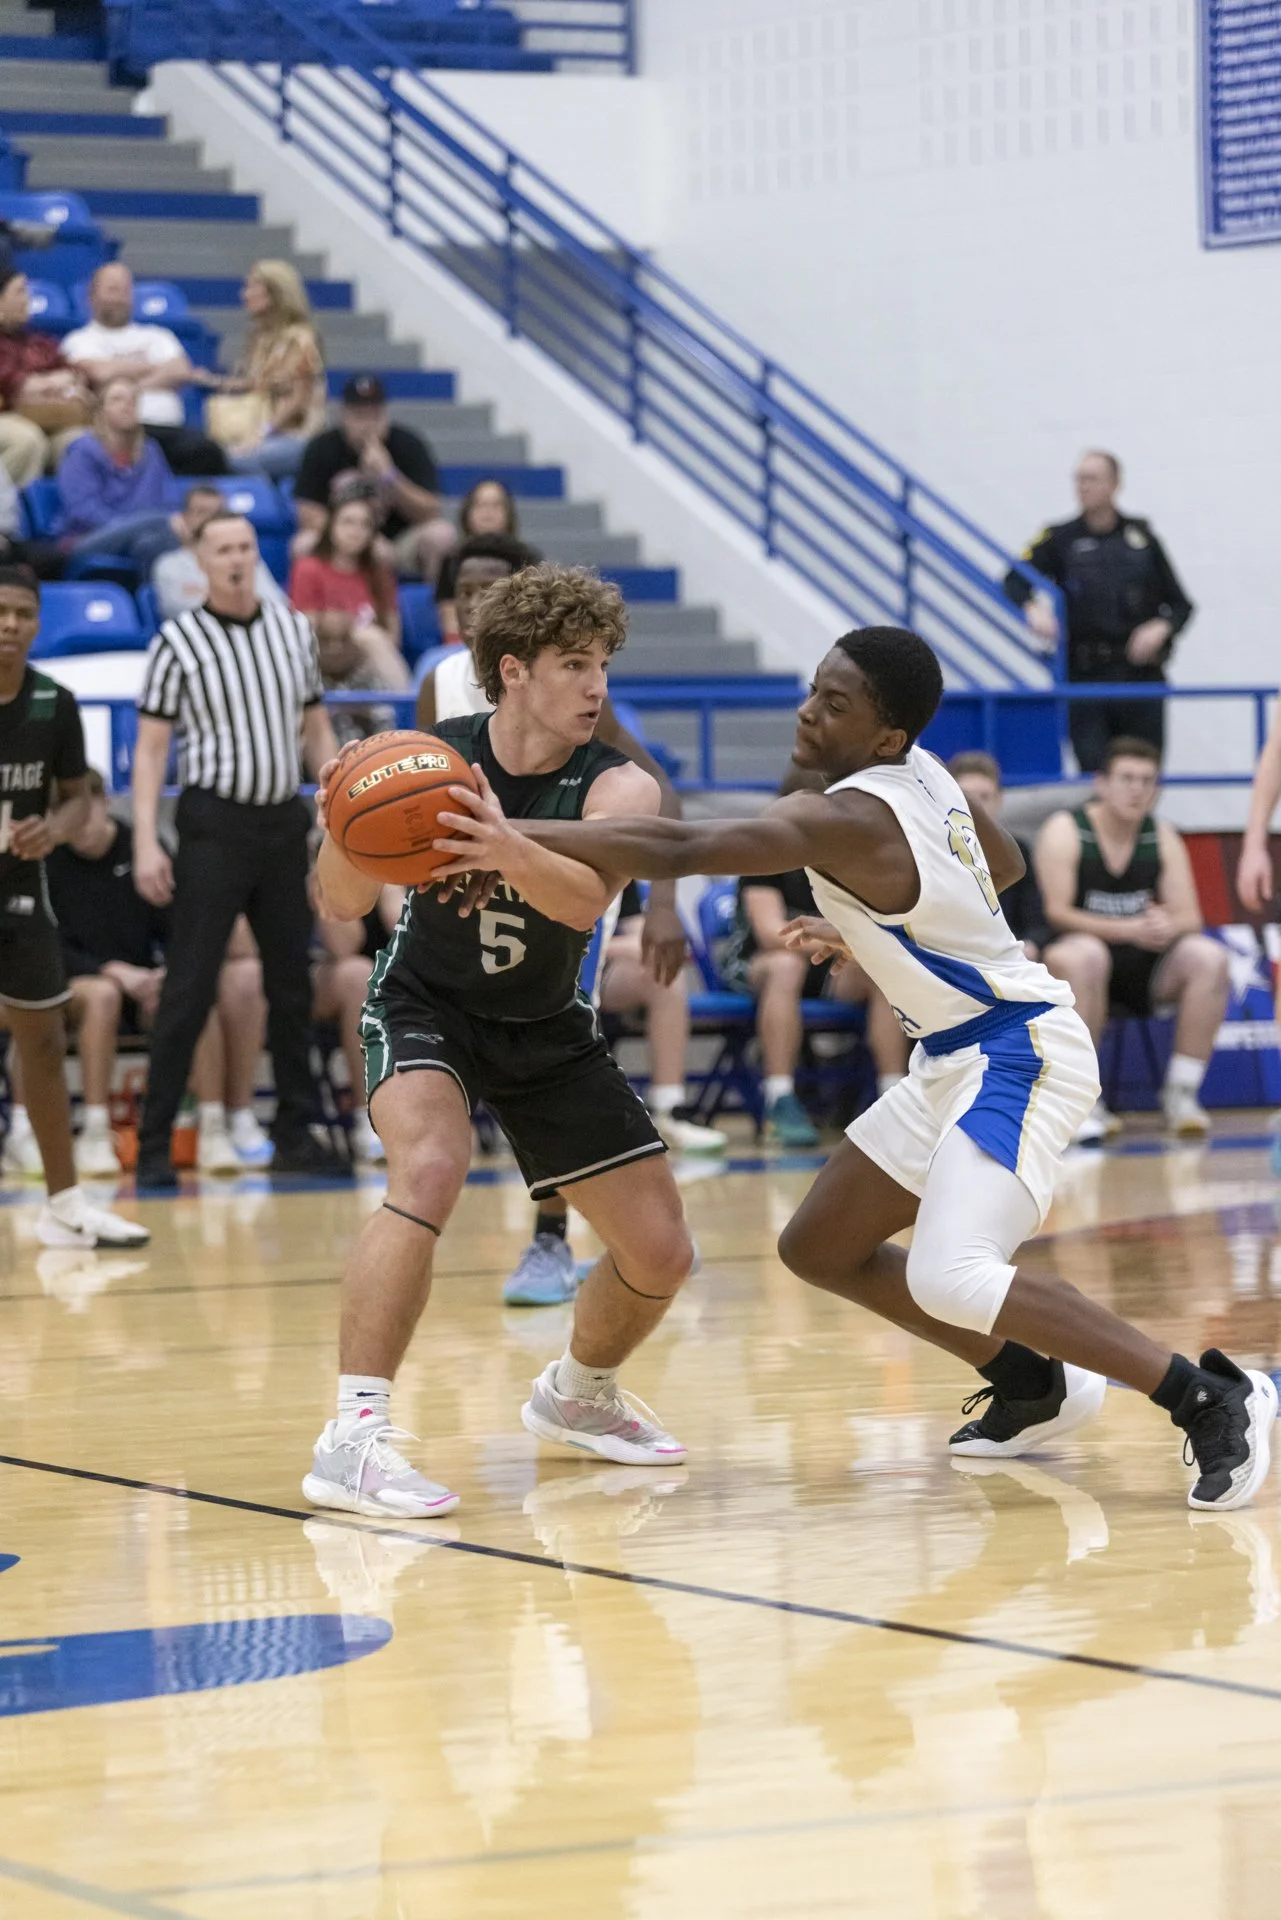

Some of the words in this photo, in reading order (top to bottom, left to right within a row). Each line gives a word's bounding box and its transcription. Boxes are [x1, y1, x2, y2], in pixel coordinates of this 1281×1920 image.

[347, 756, 417, 801] ELITE
[416, 754, 451, 770] PRO
[479, 910, 527, 975] 5
